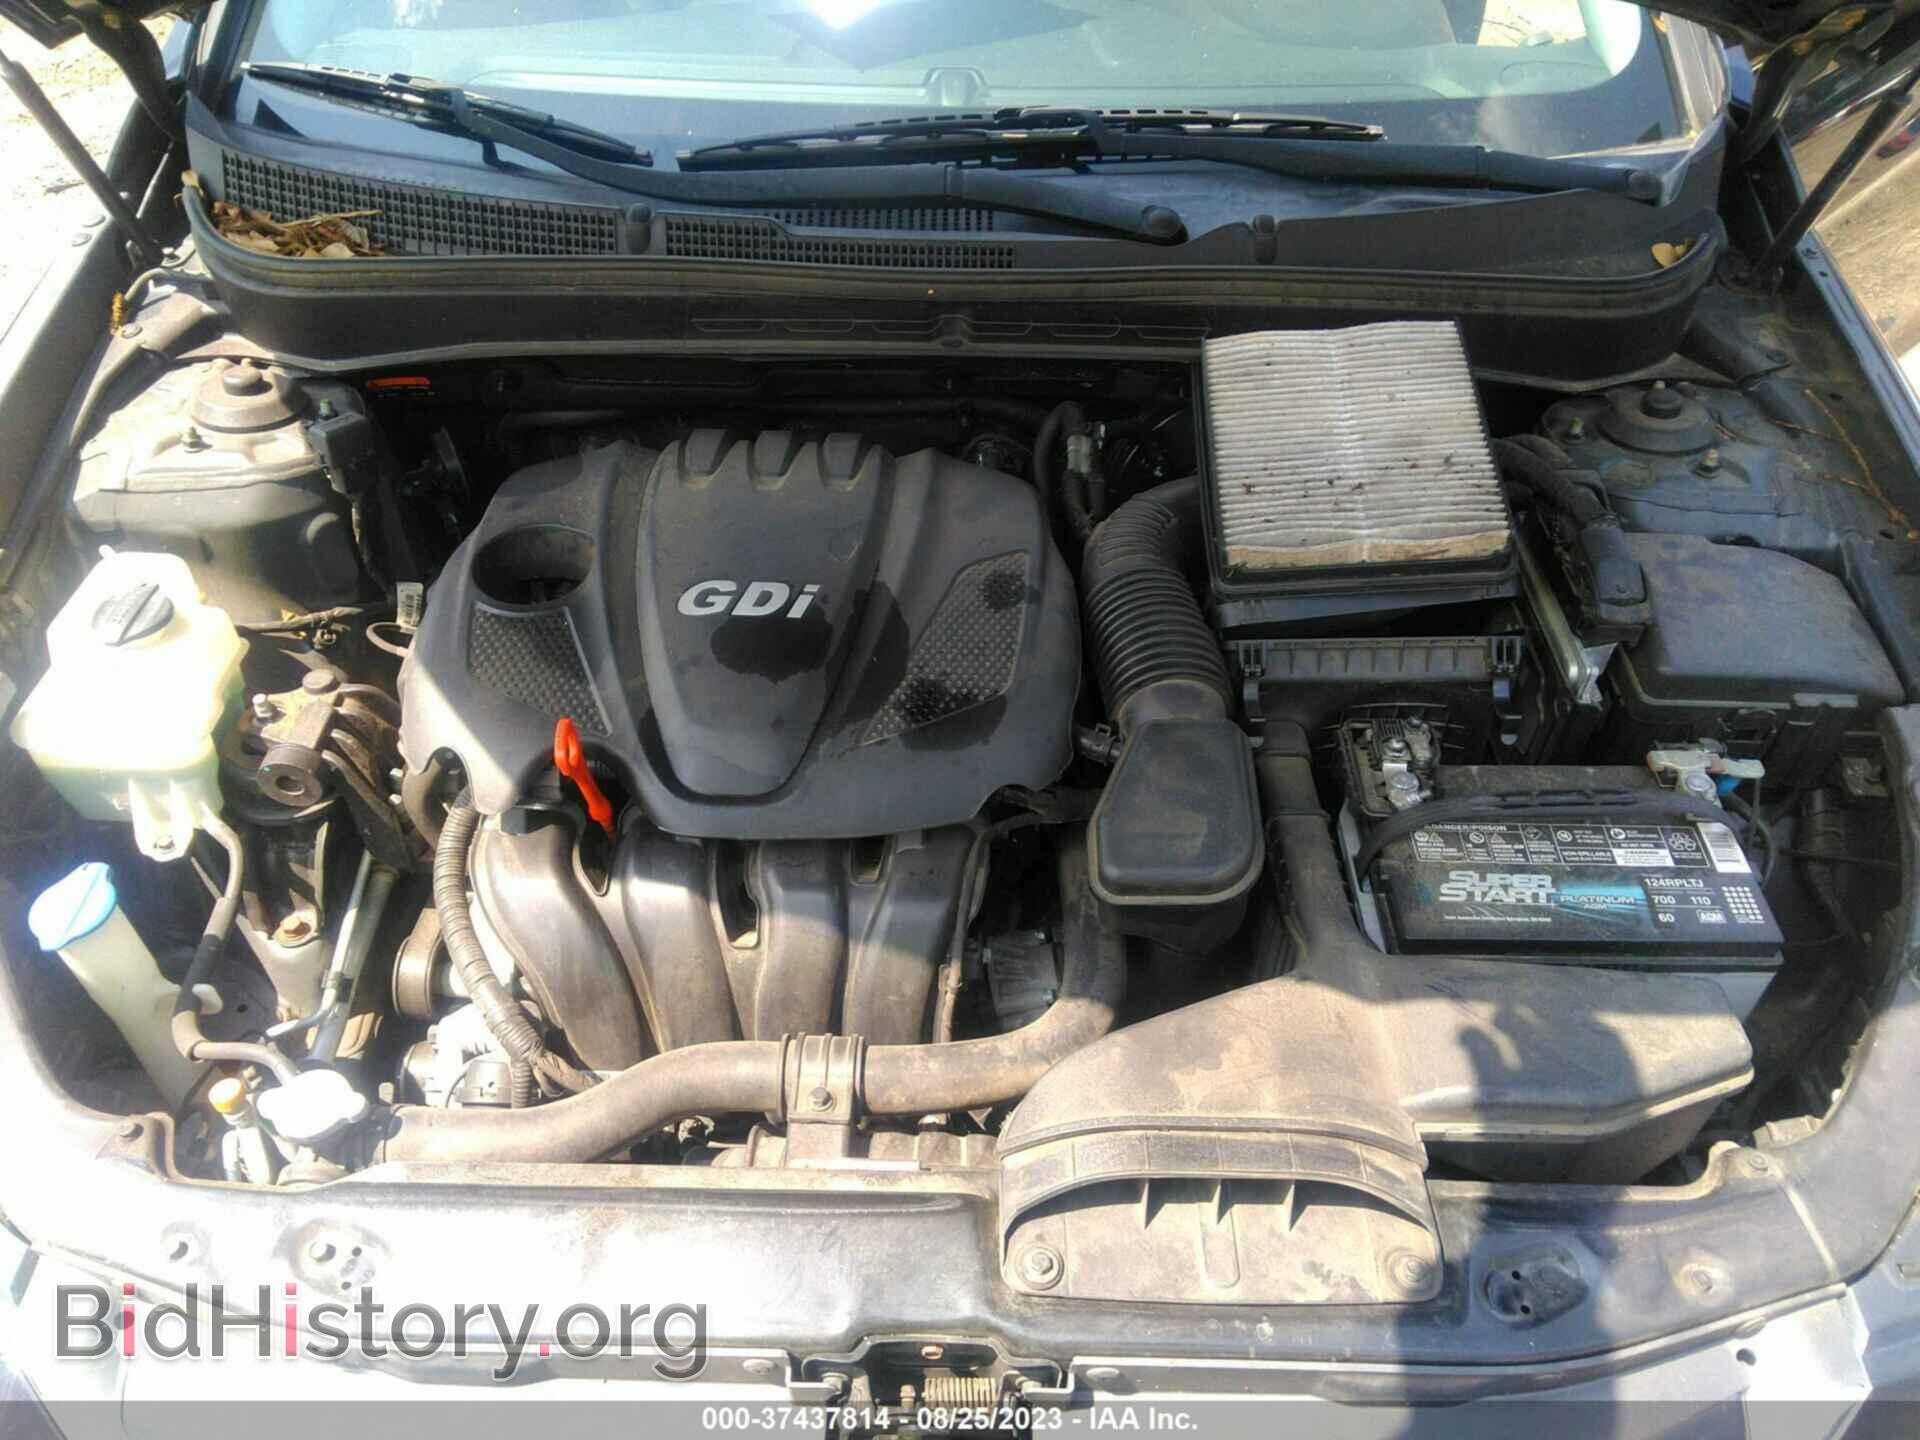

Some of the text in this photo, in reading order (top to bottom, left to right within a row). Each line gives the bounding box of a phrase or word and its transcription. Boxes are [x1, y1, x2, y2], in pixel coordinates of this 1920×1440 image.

[677, 580, 820, 618] GDi
[1448, 870, 1553, 889] SUPER
[1439, 884, 1556, 906] START
[1560, 895, 1634, 904] PLATINUM
[1652, 895, 1712, 905] 700 110
[1658, 912, 1675, 922] 60
